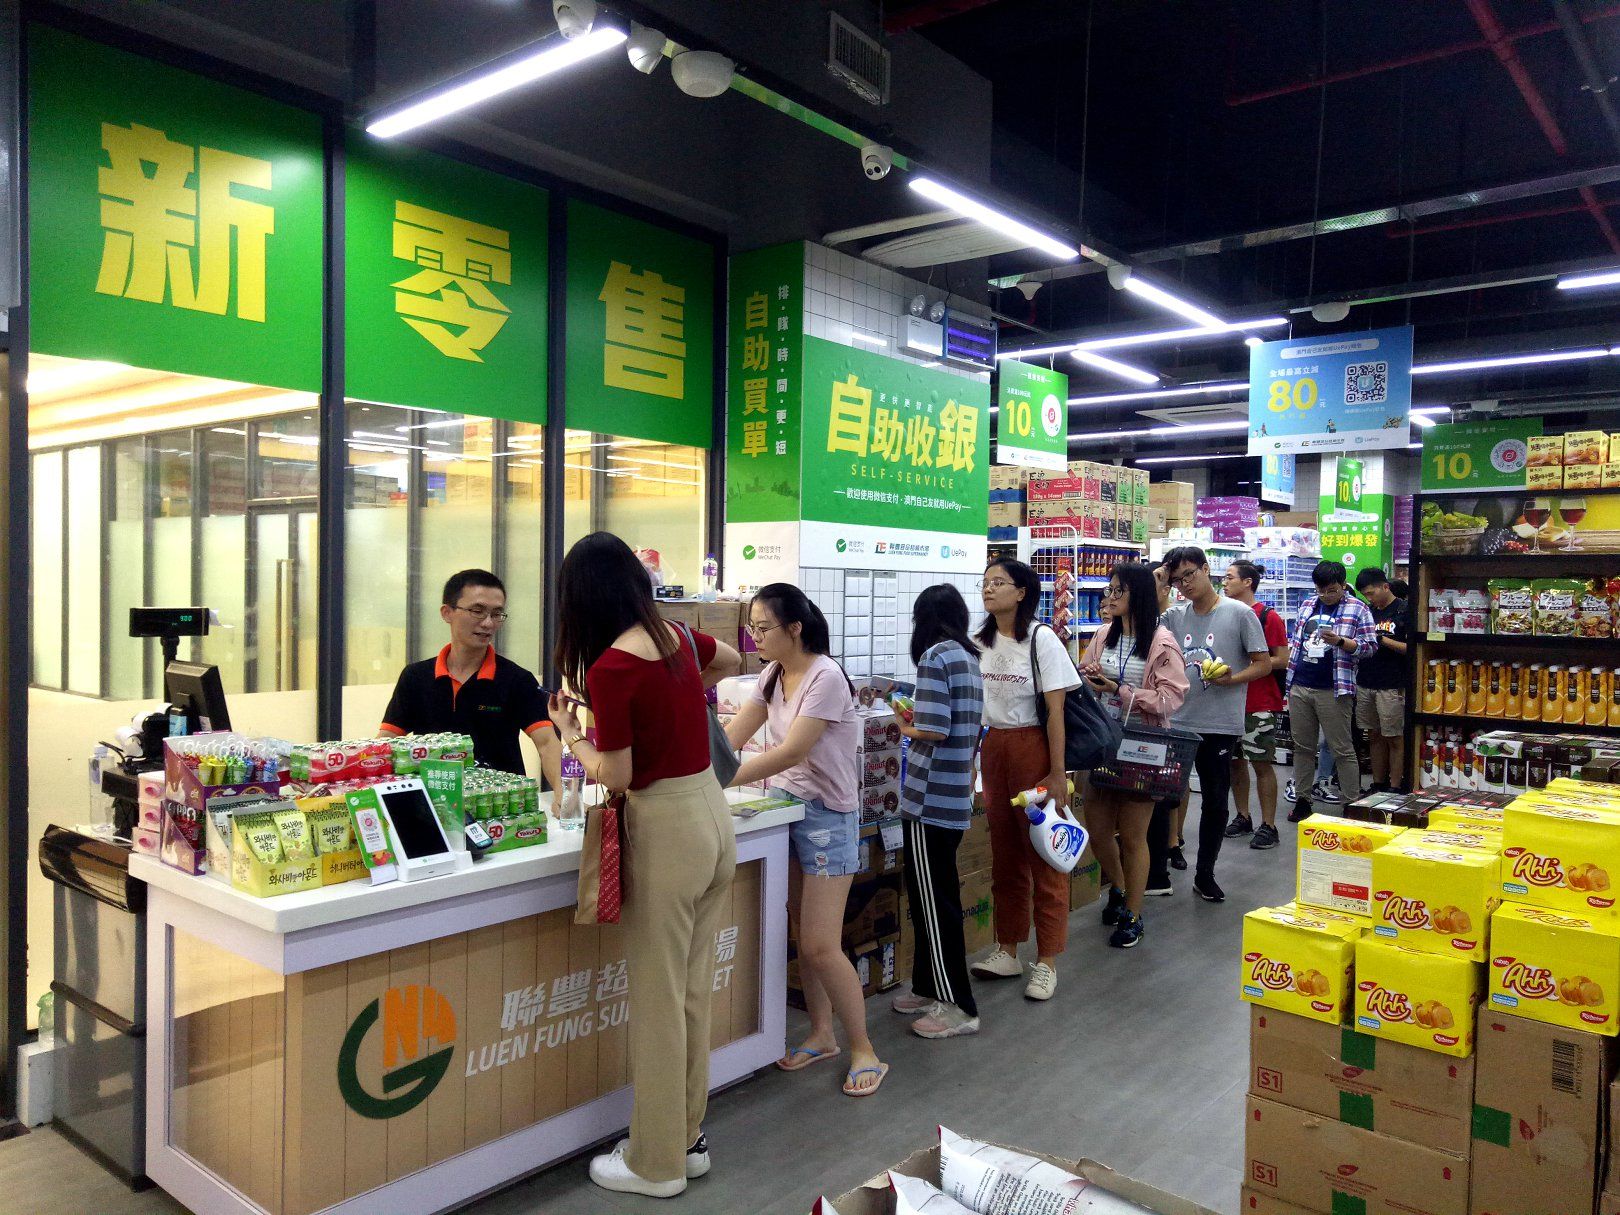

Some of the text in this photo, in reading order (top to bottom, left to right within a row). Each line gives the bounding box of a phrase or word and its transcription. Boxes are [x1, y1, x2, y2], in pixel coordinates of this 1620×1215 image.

[94, 122, 687, 400] 新零售
[741, 290, 770, 459] 自助買單
[1267, 377, 1318, 413] 80
[826, 374, 979, 474] 自助收銀
[1006, 399, 1031, 437] 10
[851, 463, 954, 489] SELF-SERVICE
[1432, 452, 1472, 480] 10
[1338, 480, 1350, 503] 10
[866, 726, 886, 737] Donut
[327, 753, 344, 767] 50
[362, 758, 385, 766] Yakult
[413, 747, 427, 759] 50
[866, 759, 886, 770] Donut
[864, 795, 884, 806] Donut
[488, 825, 503, 838] 50
[465, 1011, 595, 1077] LUEN FUNG
[1260, 1071, 1280, 1089] S1
[1254, 1165, 1275, 1184] S1
